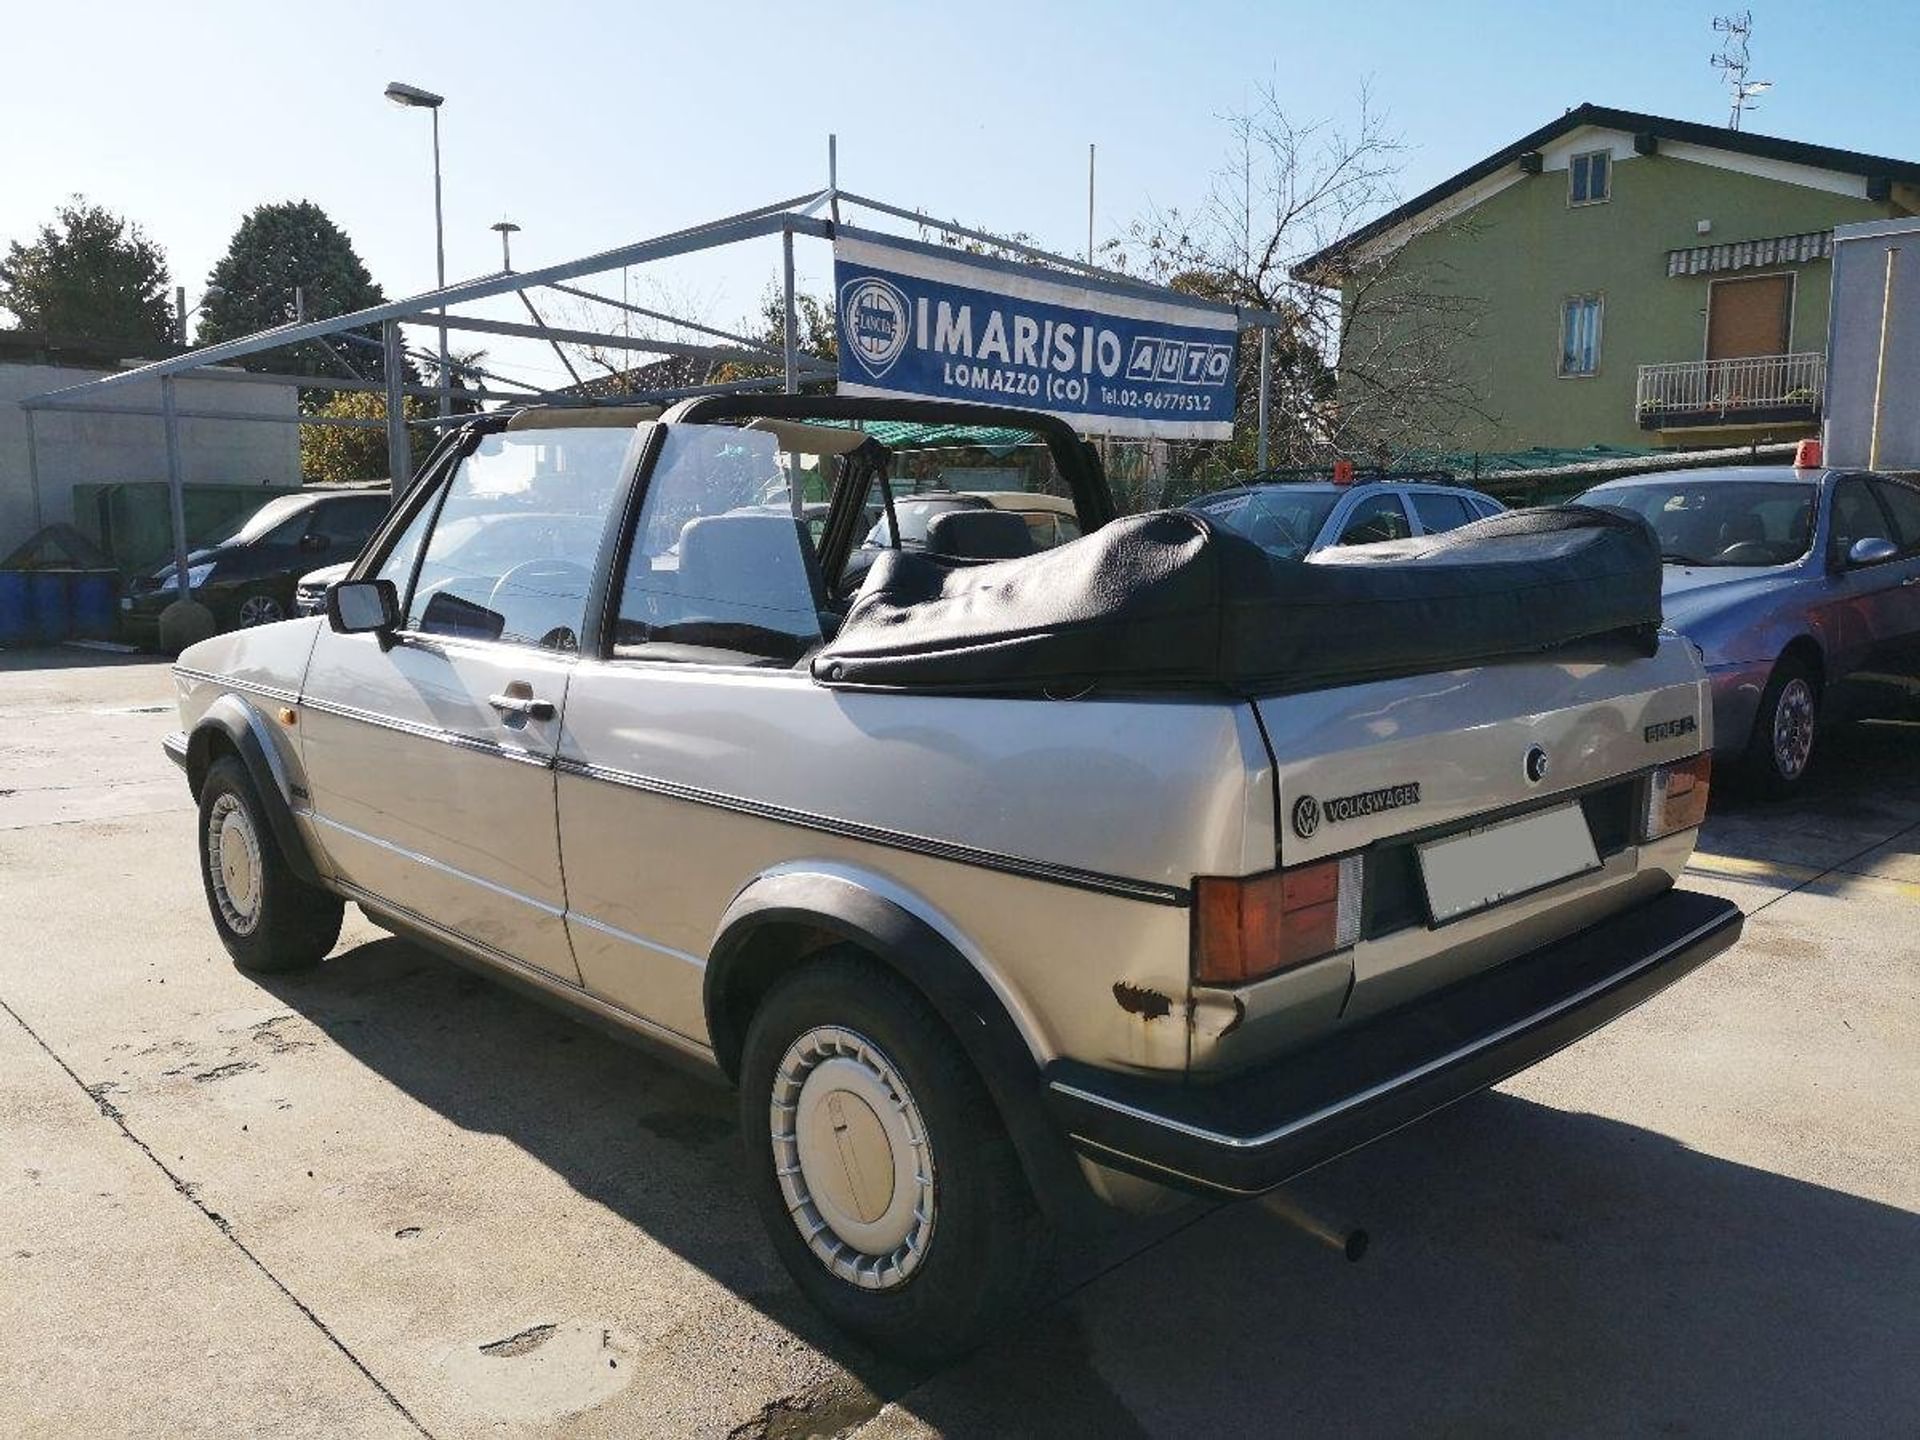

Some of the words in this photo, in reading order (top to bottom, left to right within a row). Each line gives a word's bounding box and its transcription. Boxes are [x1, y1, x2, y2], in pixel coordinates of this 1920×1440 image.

[916, 297, 1122, 378] IMARISIO
[1130, 344, 1230, 378] AUTO
[943, 362, 1040, 397] LOMAZZO
[1046, 373, 1089, 405] (CO)
[1324, 782, 1421, 822] VOLKSWAGEN
